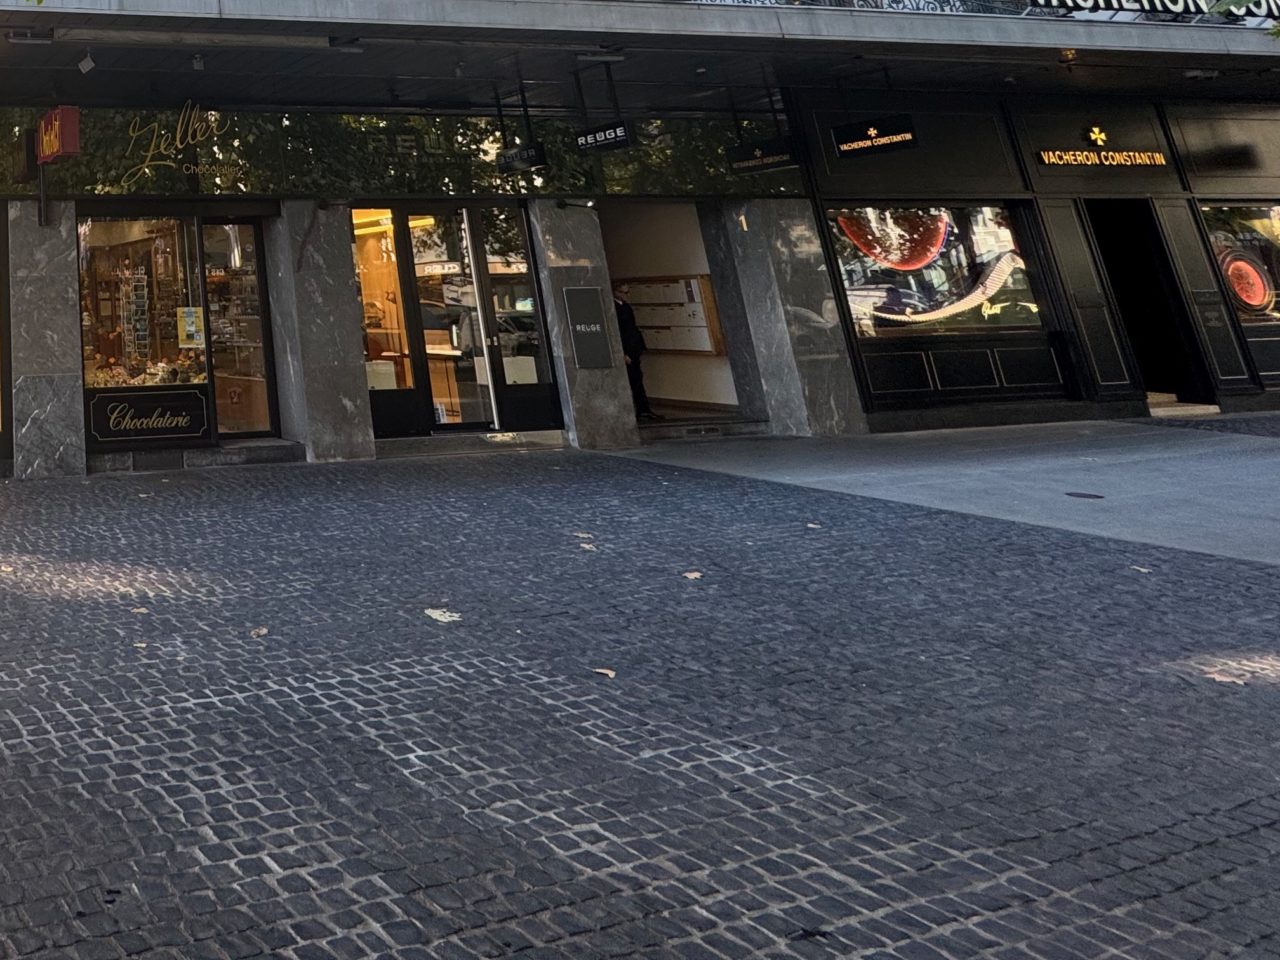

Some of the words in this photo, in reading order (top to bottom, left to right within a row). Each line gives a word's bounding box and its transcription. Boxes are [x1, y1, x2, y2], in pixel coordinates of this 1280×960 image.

[120, 99, 230, 186] Zeller
[577, 127, 626, 146] REUGE
[839, 139, 872, 151] VACHERON
[872, 133, 913, 146] CONSTANTIN
[1040, 150, 1100, 165] VACHERON
[1100, 151, 1167, 166] CONSTANTIN
[182, 163, 240, 175] Chocolatier
[738, 215, 748, 231] 1
[576, 324, 601, 332] REUGE
[107, 402, 191, 431] Chocolaterie
